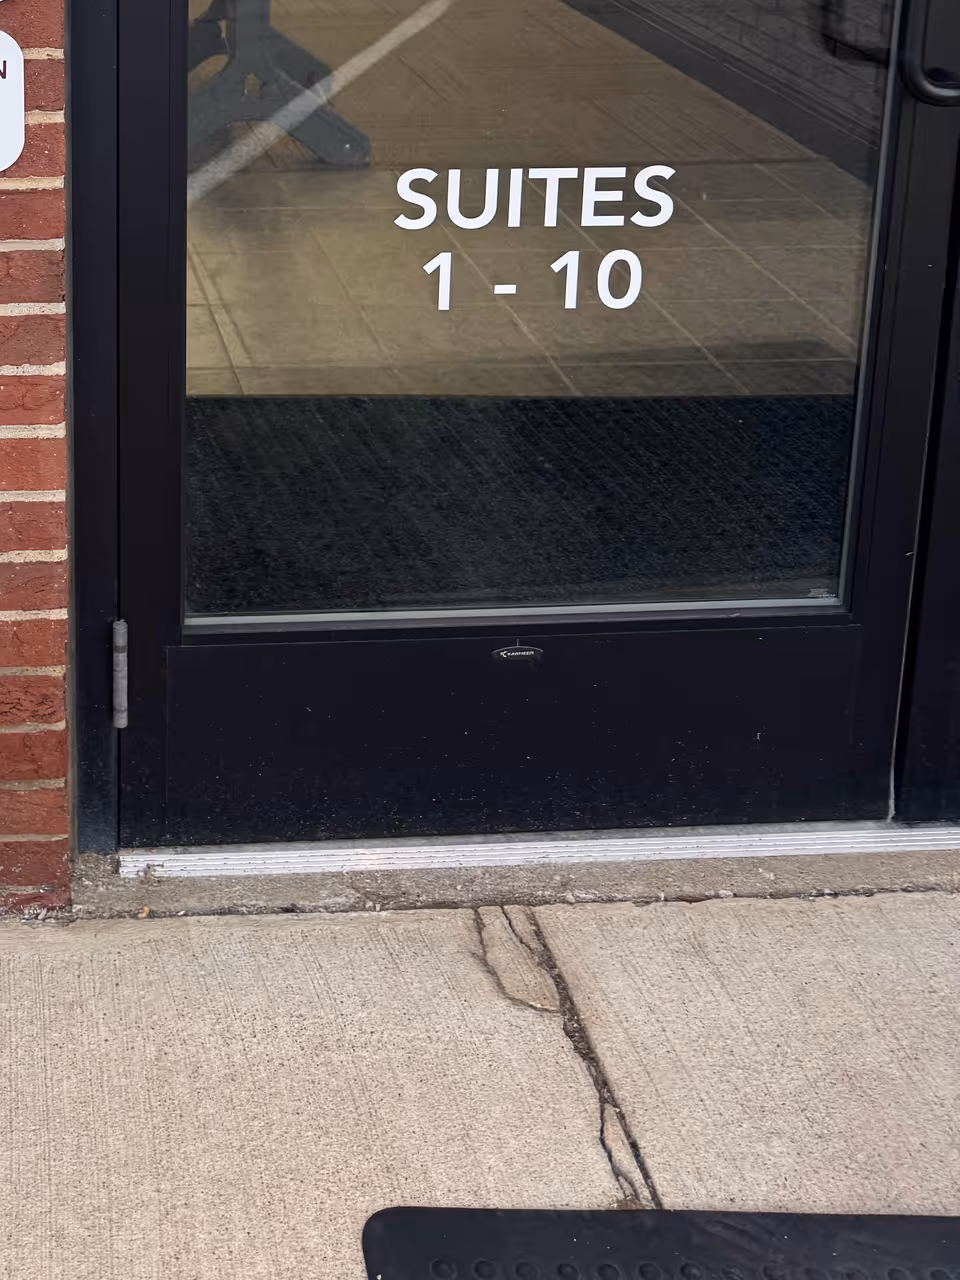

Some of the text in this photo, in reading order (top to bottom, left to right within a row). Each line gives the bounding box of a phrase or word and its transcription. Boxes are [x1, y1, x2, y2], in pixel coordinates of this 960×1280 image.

[393, 165, 677, 230] SUITES
[422, 249, 643, 311] 1 - 10
